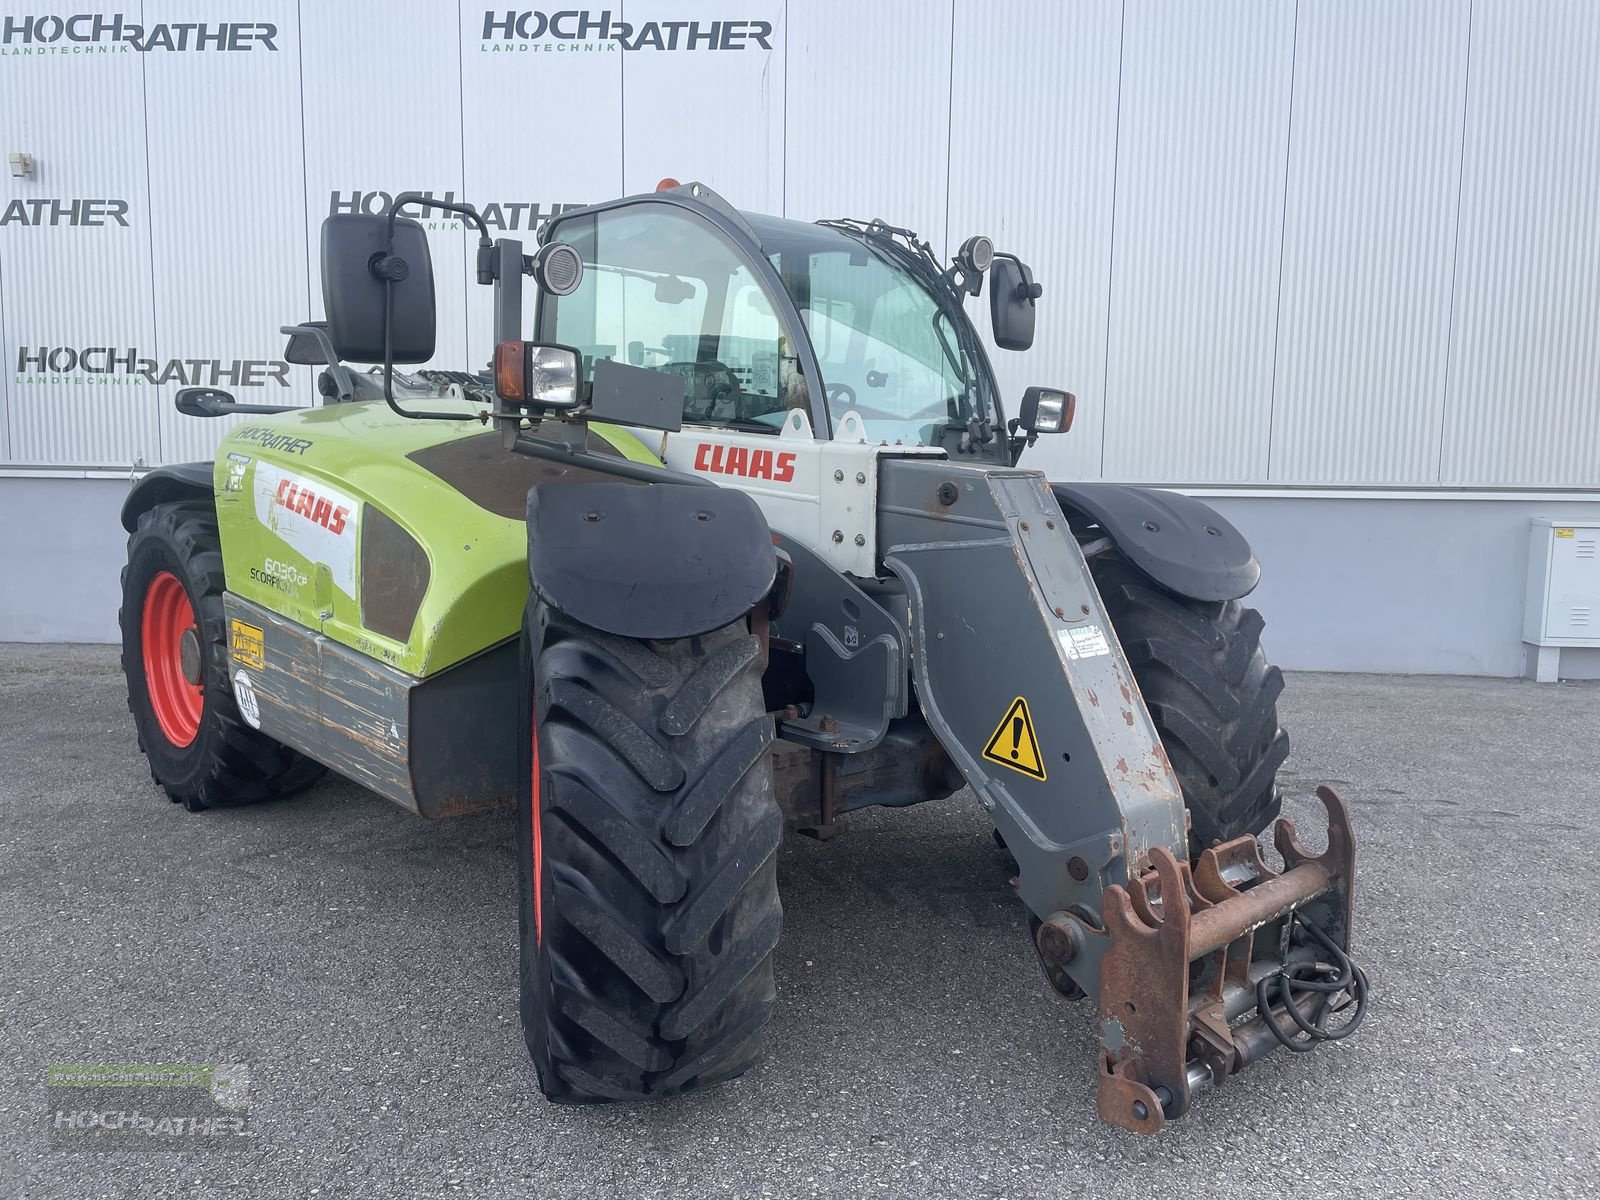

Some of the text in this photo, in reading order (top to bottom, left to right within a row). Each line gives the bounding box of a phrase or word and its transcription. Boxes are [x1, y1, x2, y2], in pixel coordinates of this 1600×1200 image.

[3, 14, 278, 51] HOCHRATHER
[481, 43, 616, 52] LANDTECHNIK
[482, 10, 773, 50] HOCHRATHER
[1, 45, 128, 56] LANDTECHNIK
[330, 191, 590, 231] HOCHRATH
[16, 377, 142, 385] LANDTECHNIK
[17, 346, 291, 387] HOCHRATHER
[236, 427, 314, 456] HOCHRATHER
[694, 443, 797, 482] CLAAS
[276, 479, 350, 535] CLAAS
